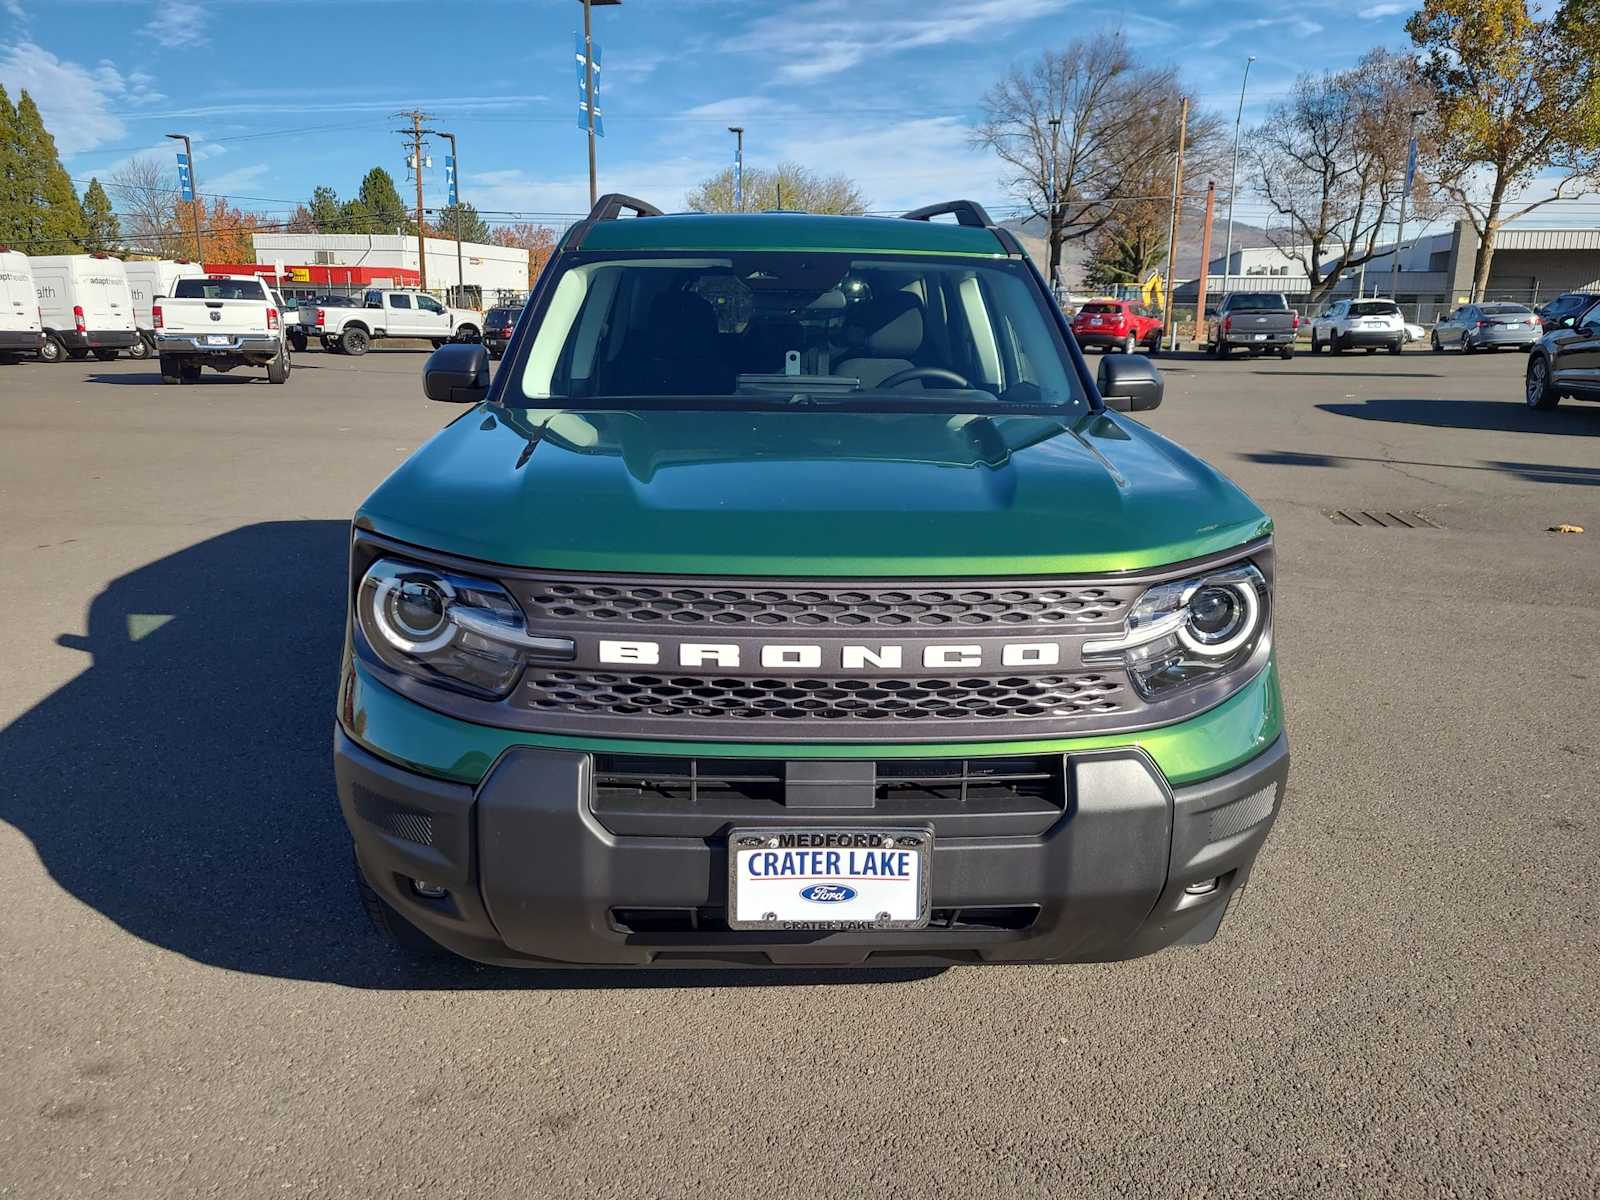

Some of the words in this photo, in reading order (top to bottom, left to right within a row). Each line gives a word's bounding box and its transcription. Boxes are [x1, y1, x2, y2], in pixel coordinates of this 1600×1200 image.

[599, 640, 1060, 668] BRONCO
[779, 834, 883, 848] MEDFORD
[748, 851, 841, 876] CRATER
[849, 851, 910, 876] LAKE
[810, 885, 846, 901] Ford
[783, 921, 836, 930] CRATER
[839, 921, 874, 930] LAKE
